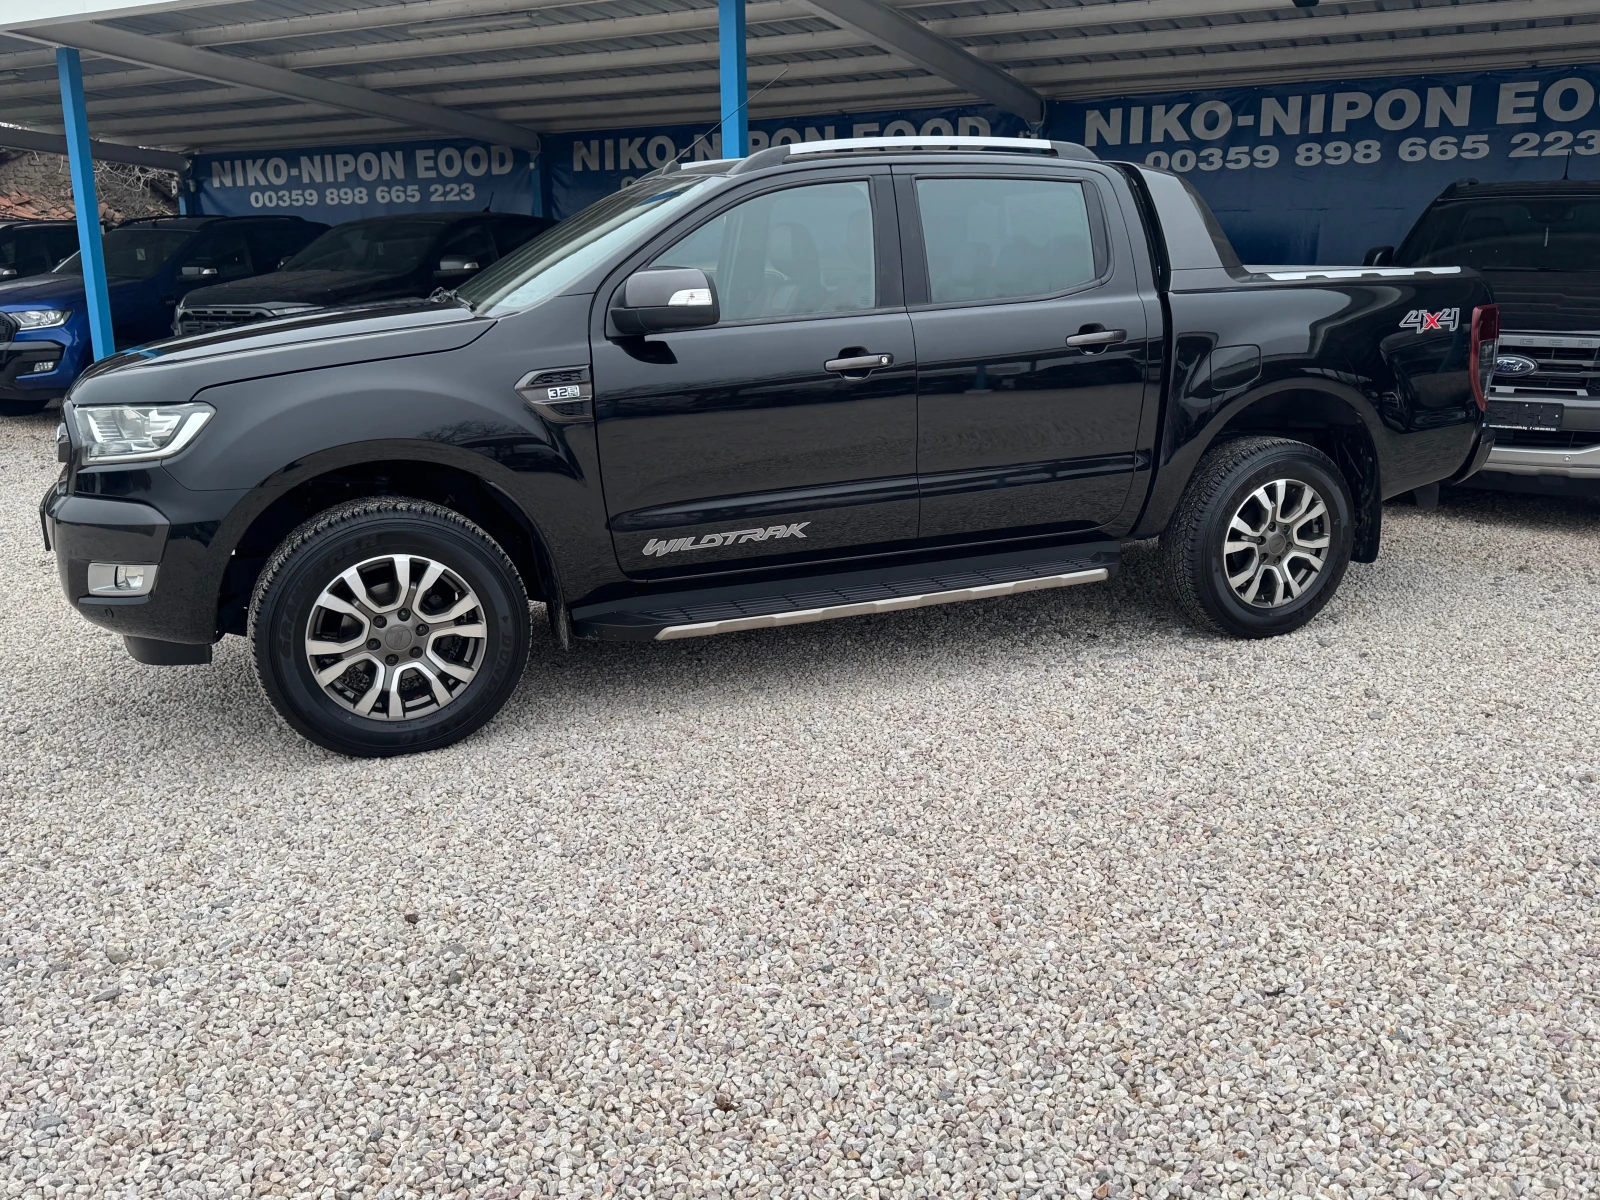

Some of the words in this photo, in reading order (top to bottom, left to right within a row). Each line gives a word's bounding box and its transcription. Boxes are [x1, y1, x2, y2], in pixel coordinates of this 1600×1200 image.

[1084, 85, 1473, 147] NIKO-NIPON
[1496, 77, 1600, 125] EO
[211, 150, 405, 188] NIKO-NIPON
[415, 145, 514, 179] EOOD
[573, 125, 835, 171] NIKO-NPON
[1145, 145, 1280, 173] 00359
[1295, 139, 1382, 167] 898
[1398, 134, 1490, 162] 665
[1508, 129, 1600, 158] 223
[250, 189, 318, 208] 00359
[325, 187, 369, 206] 898
[375, 185, 421, 204] 665
[429, 183, 476, 202] 223
[642, 521, 812, 557] WILDTRAK
